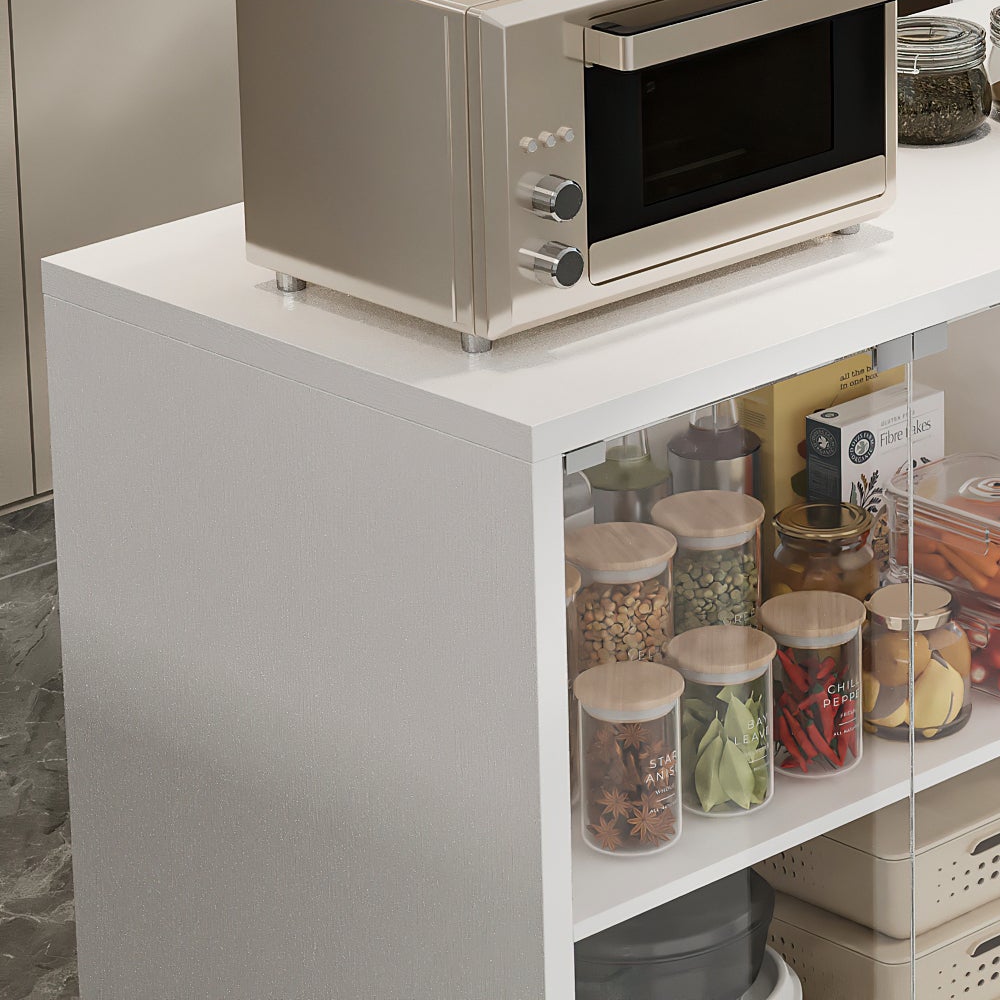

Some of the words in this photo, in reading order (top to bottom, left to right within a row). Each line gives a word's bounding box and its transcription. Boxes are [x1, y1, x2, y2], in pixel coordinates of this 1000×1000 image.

[840, 373, 850, 381] all
[851, 368, 865, 377] the
[850, 378, 864, 387] one
[865, 372, 878, 381] box
[880, 430, 903, 447] Fibre
[827, 680, 860, 695] CHIL
[823, 688, 860, 708] PEPPE
[645, 765, 676, 784] ANIS
